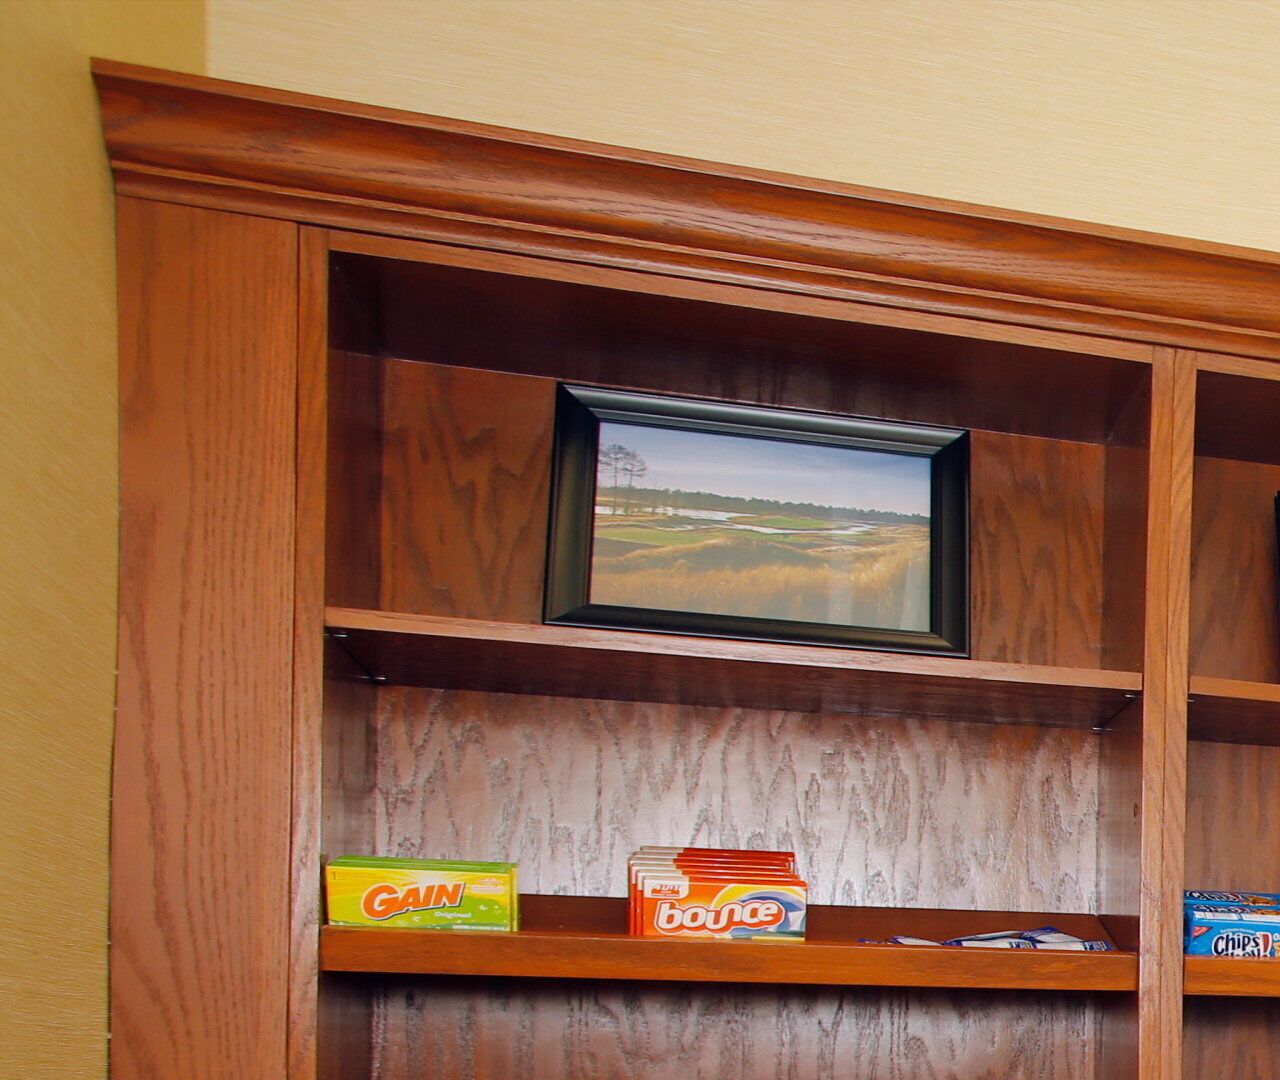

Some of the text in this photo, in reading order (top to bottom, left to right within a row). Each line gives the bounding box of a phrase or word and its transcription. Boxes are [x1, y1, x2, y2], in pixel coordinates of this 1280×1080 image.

[362, 883, 465, 920] GAIN
[657, 900, 782, 931] bounce
[1213, 933, 1260, 956] Chips
